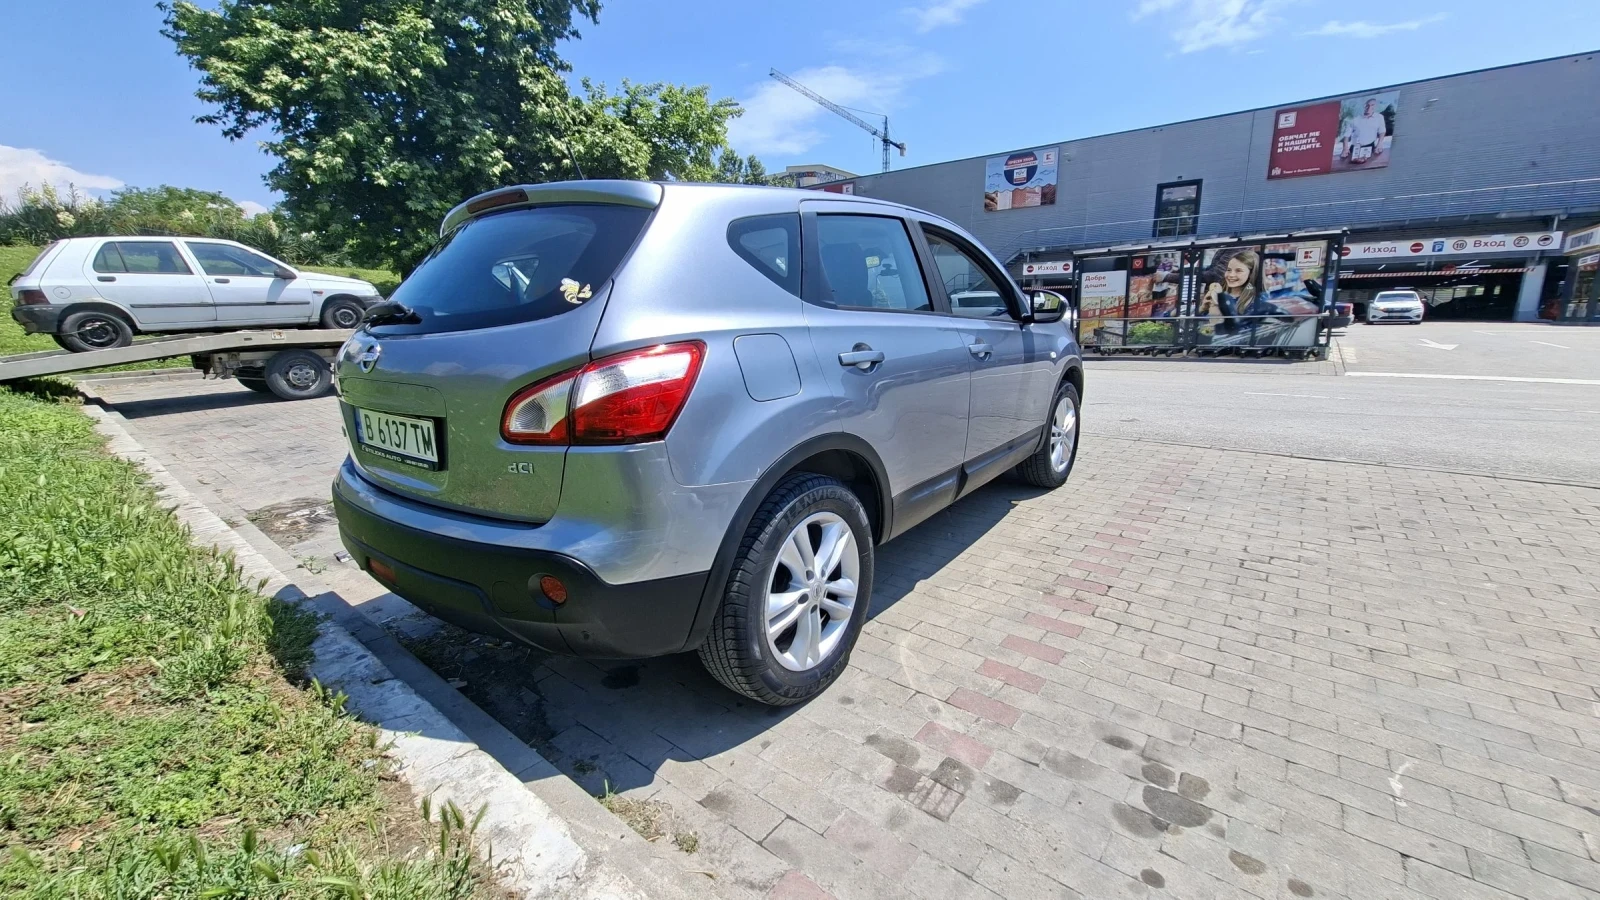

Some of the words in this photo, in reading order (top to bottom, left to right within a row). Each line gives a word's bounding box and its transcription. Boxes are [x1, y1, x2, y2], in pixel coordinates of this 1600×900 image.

[1279, 132, 1308, 142] ОБИЧАТ
[1473, 239, 1506, 248] Вход
[1363, 246, 1397, 254] Изход
[1084, 274, 1107, 282] Добре
[1084, 282, 1107, 290] дошли
[364, 413, 374, 441] B
[378, 416, 407, 451] 6137
[410, 422, 435, 457] TM
